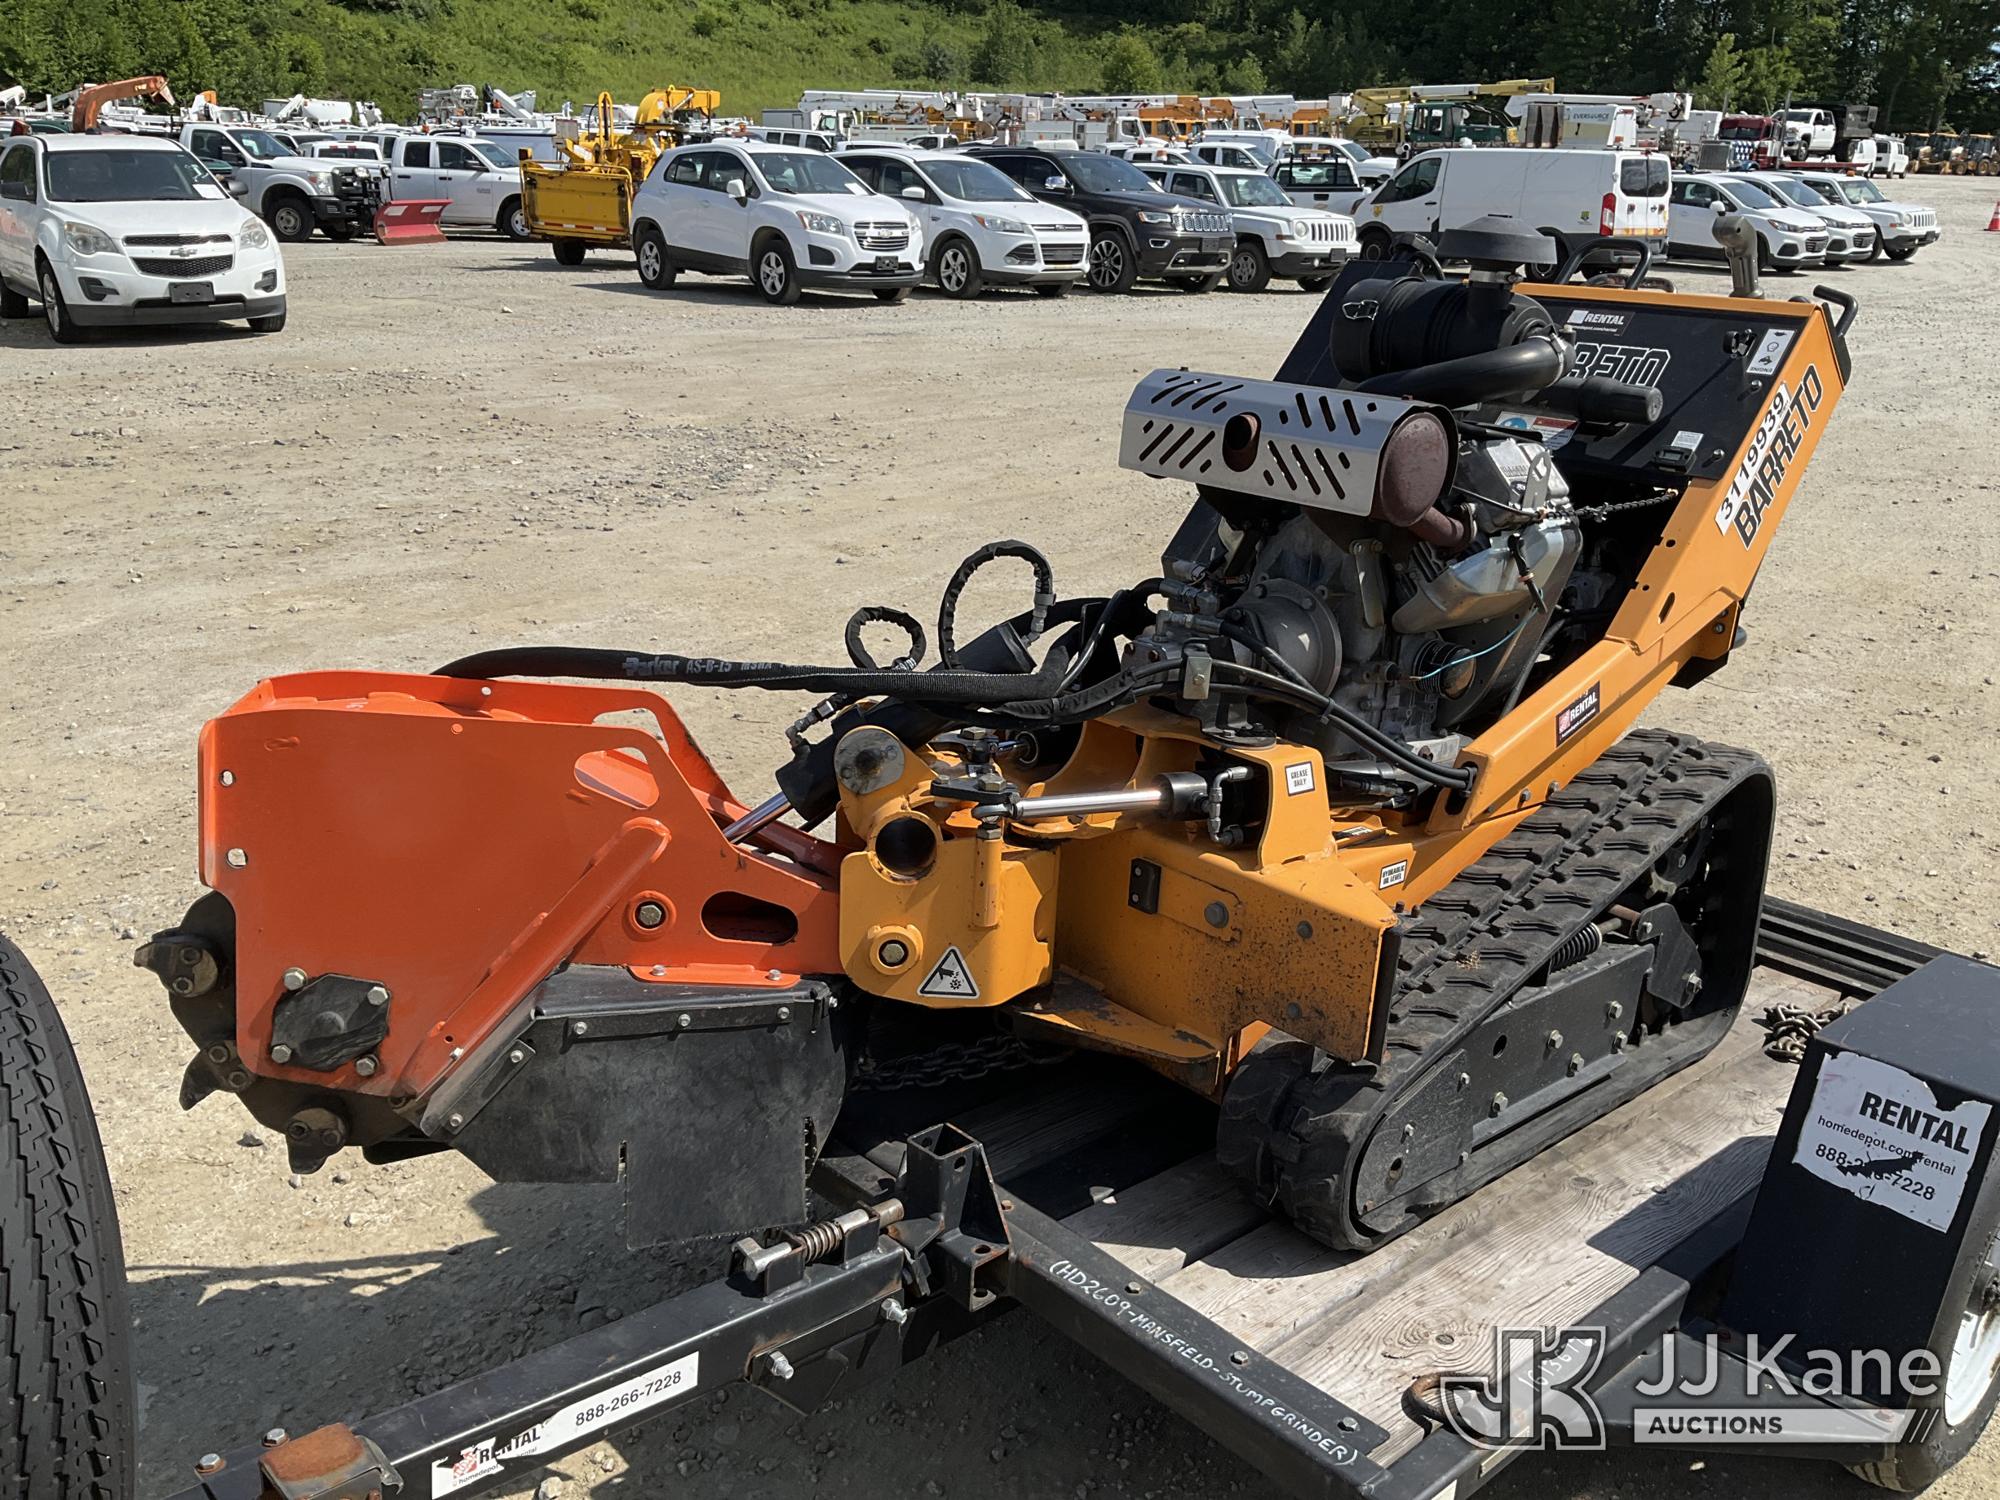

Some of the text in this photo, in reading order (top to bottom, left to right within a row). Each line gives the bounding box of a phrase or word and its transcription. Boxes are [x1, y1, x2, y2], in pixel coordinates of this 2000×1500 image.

[1584, 313, 1625, 325] RENTAL
[1721, 391, 1785, 520] 3119939
[1733, 363, 1824, 551] BARRETO
[1570, 691, 1598, 722] RENTAL
[1859, 1091, 1970, 1154] RENTAL
[575, 1371, 681, 1426] 888-266-7228
